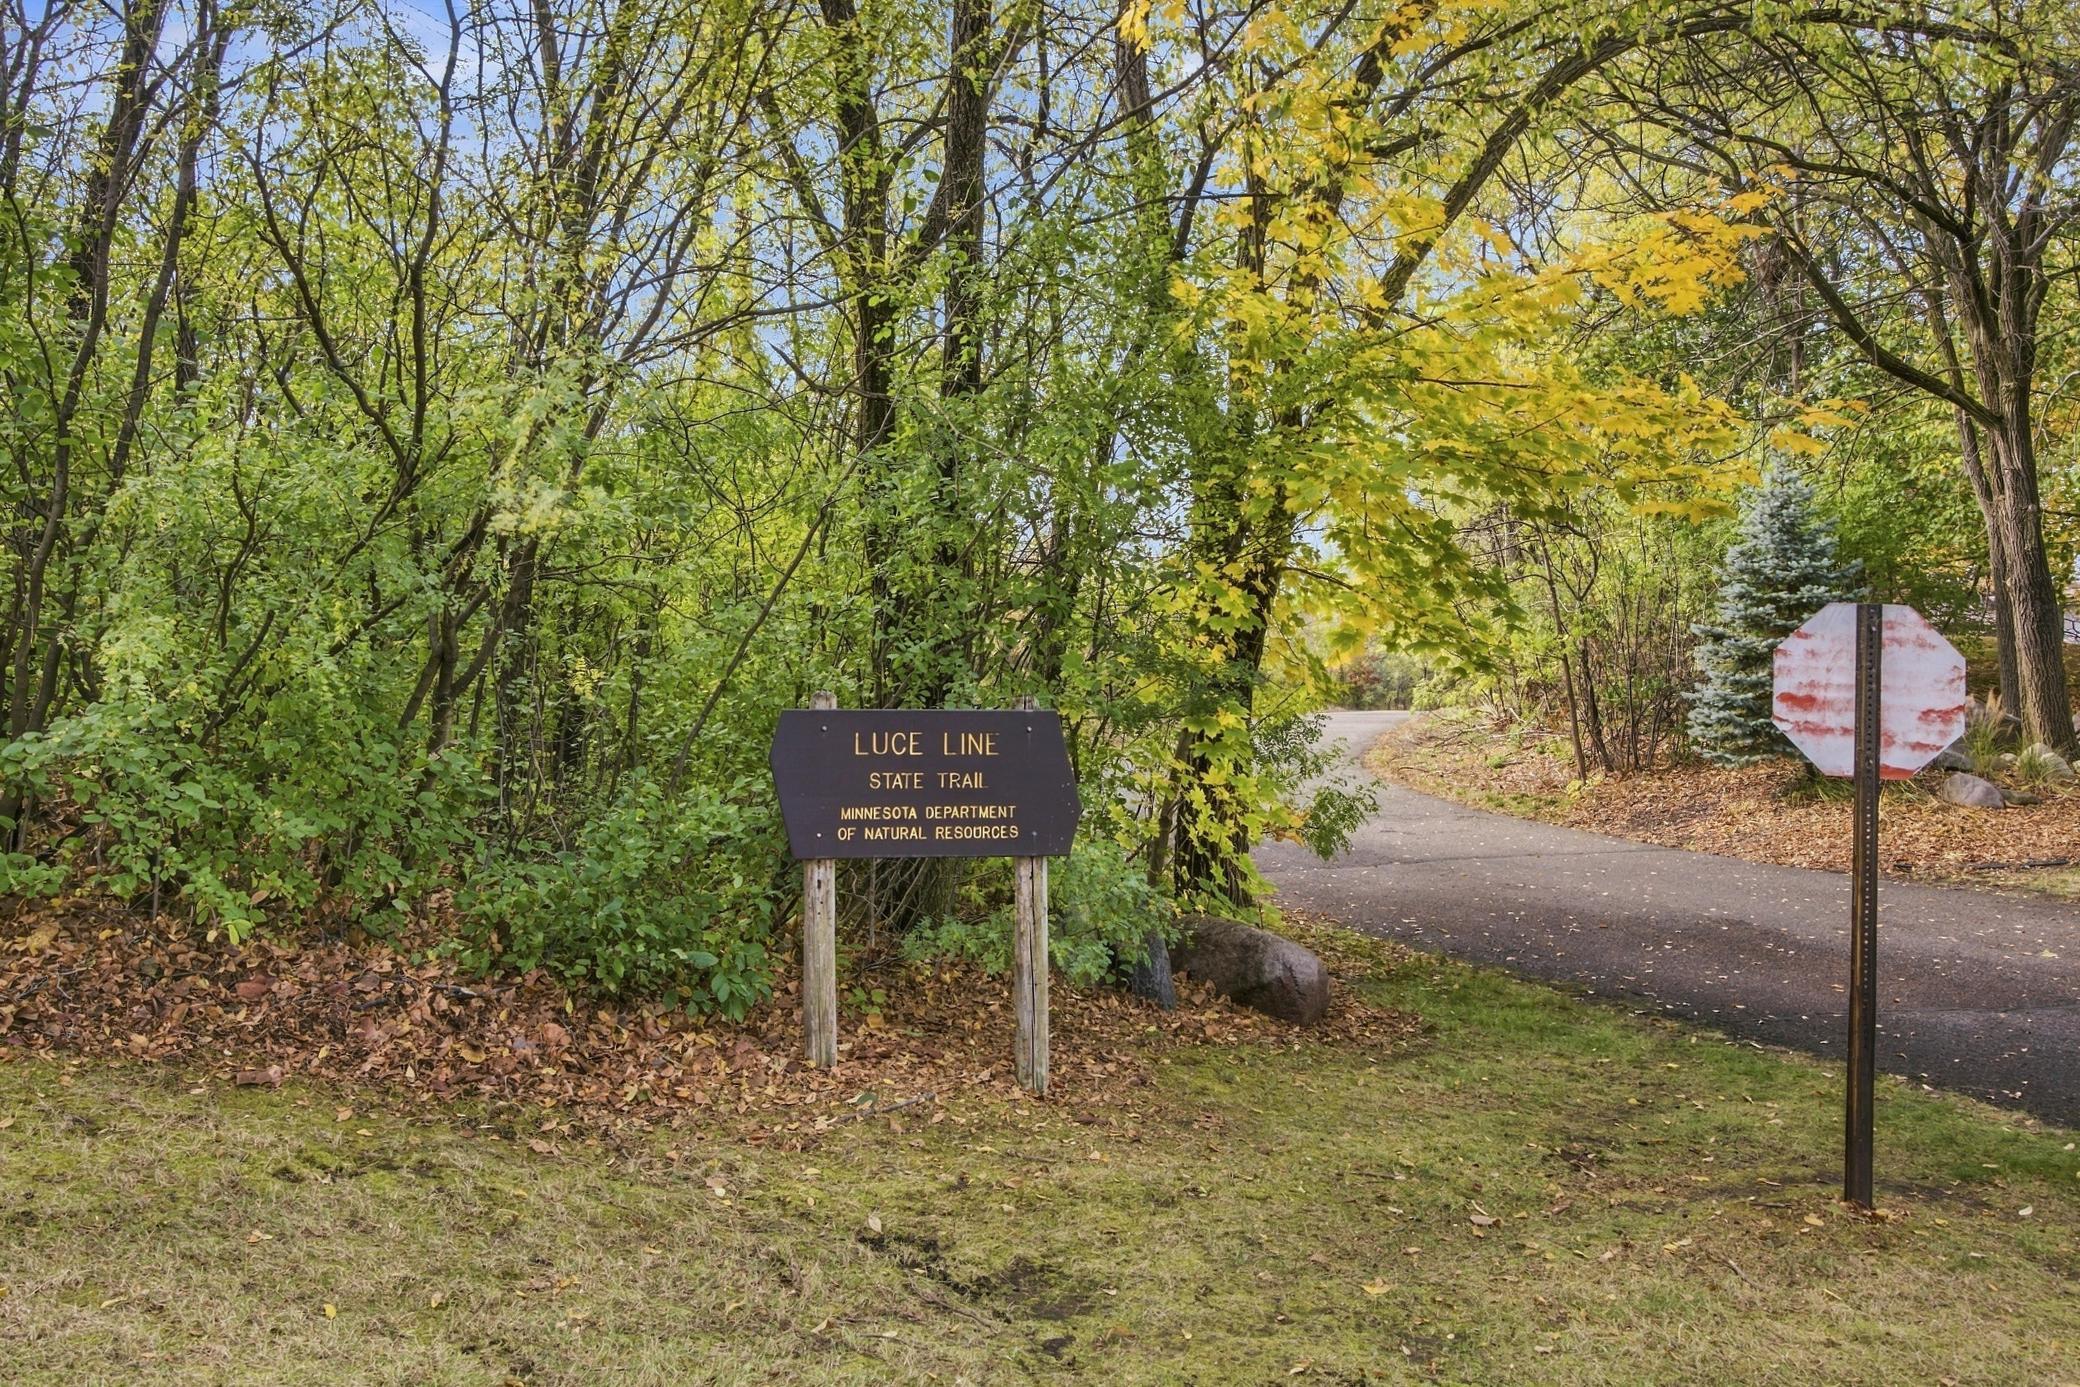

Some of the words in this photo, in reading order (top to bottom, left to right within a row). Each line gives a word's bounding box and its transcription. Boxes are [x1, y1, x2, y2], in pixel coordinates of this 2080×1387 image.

[854, 732, 924, 756] LUCE
[943, 732, 1000, 756] LINE
[869, 772, 924, 789] STATE
[937, 772, 989, 789] TRAIL
[840, 806, 917, 820] MINNESOTA
[925, 805, 1016, 819] DEPARTMENT
[837, 827, 856, 841] OF
[864, 826, 927, 840] NATURAL
[935, 825, 1019, 840] RESOURCES
